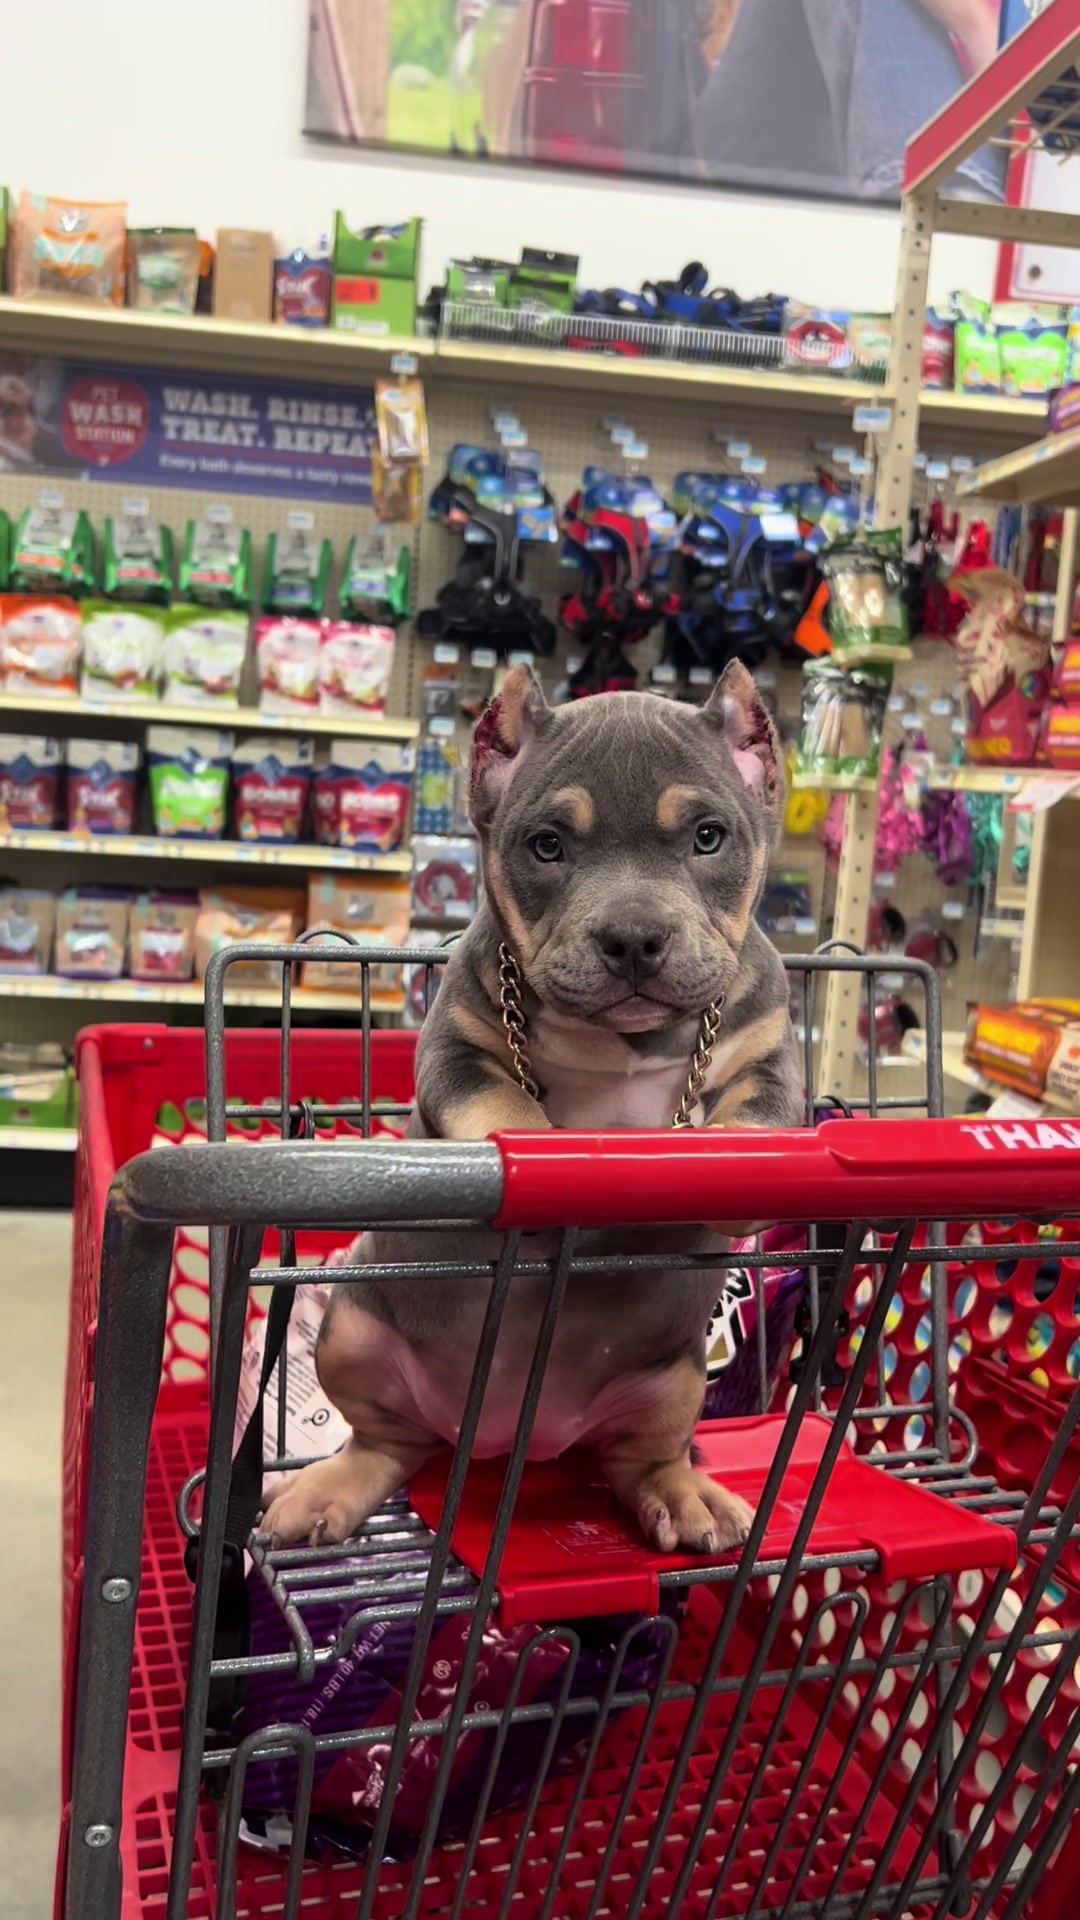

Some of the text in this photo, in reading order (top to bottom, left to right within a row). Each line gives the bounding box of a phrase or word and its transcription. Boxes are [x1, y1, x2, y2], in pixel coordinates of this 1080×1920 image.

[69, 401, 143, 427] WASH
[161, 386, 366, 429] WASH. RINSE.
[74, 424, 136, 444] STATION
[160, 415, 374, 458] TREAT. REPEA
[369, 1621, 391, 1642] NET
[340, 1659, 355, 1676] 40
